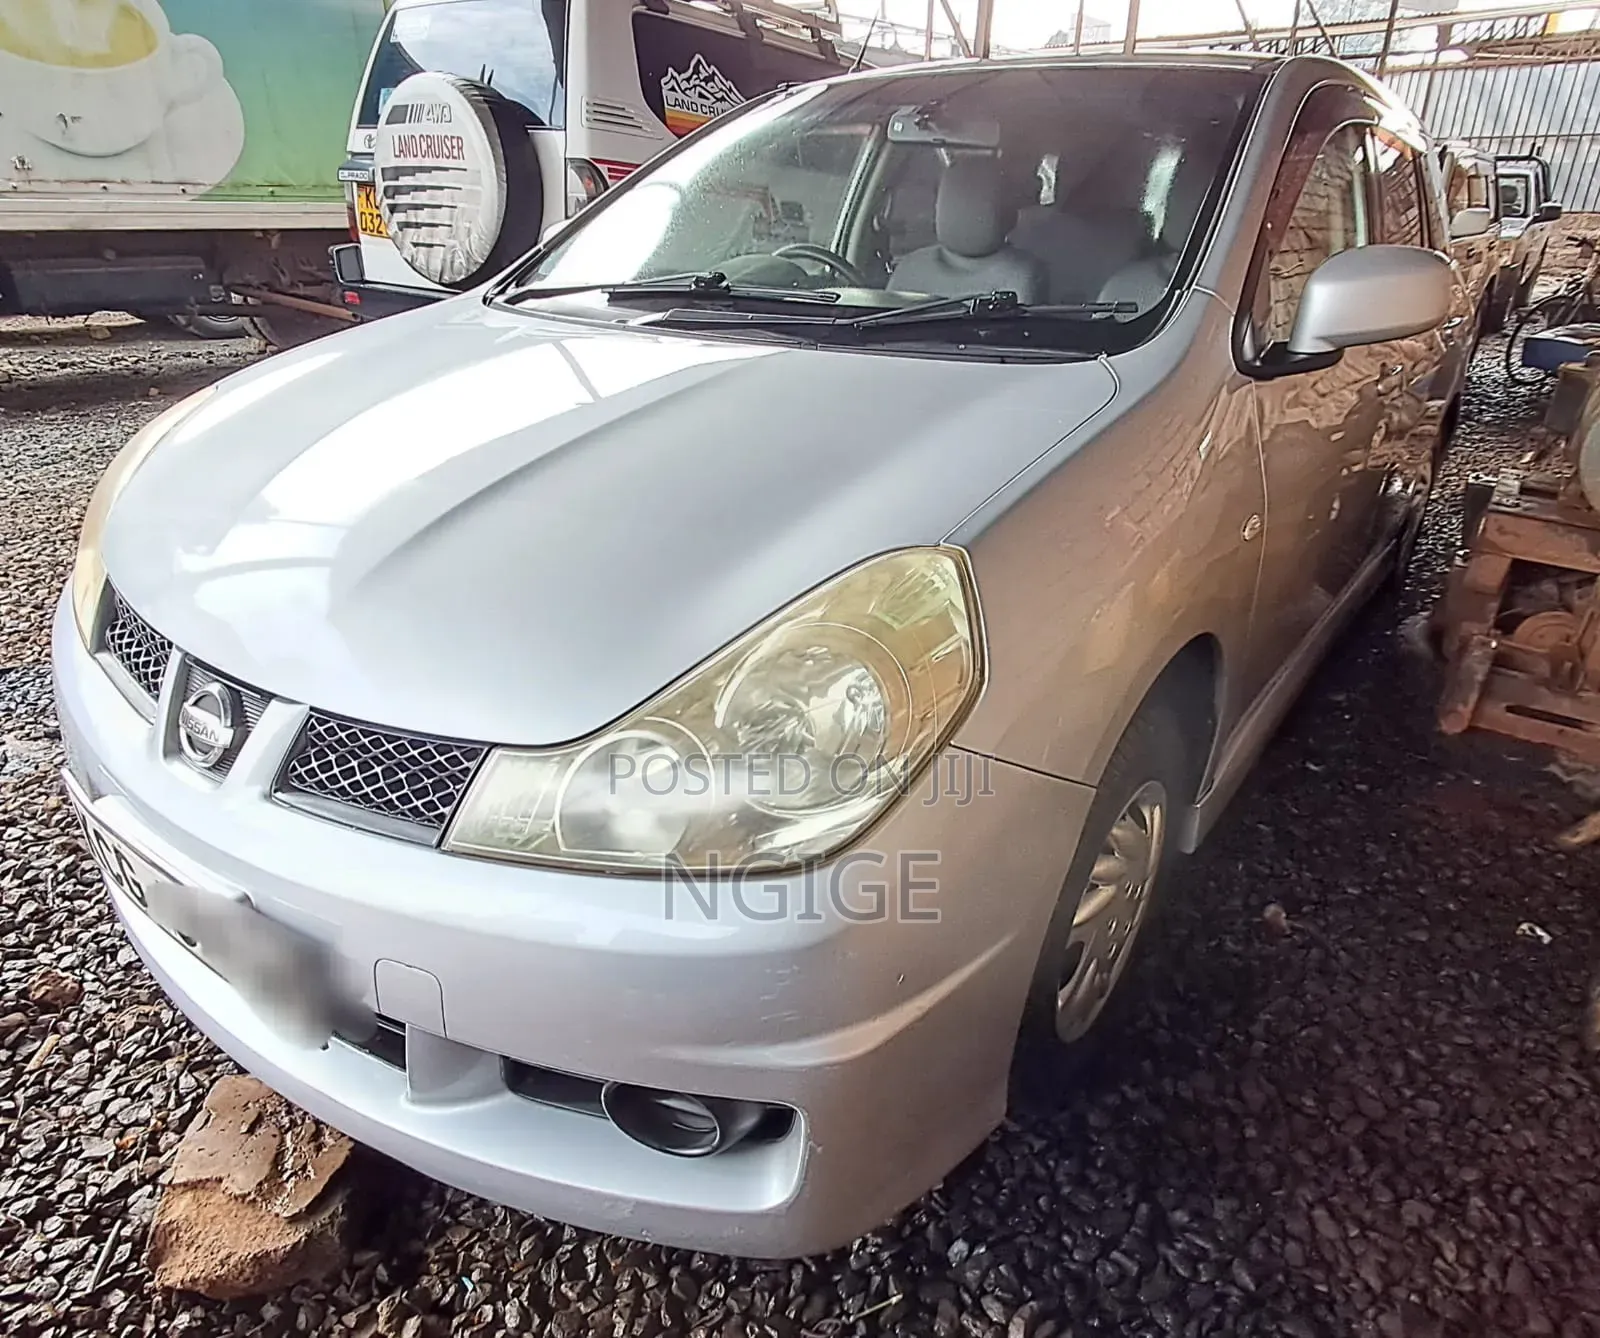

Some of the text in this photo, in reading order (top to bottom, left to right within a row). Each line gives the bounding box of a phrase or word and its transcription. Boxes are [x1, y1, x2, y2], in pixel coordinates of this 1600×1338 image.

[665, 95, 727, 117] LAND CRU
[391, 133, 466, 161] LAND CRUISER
[360, 211, 384, 235] 032
[181, 706, 220, 742] NISSAN
